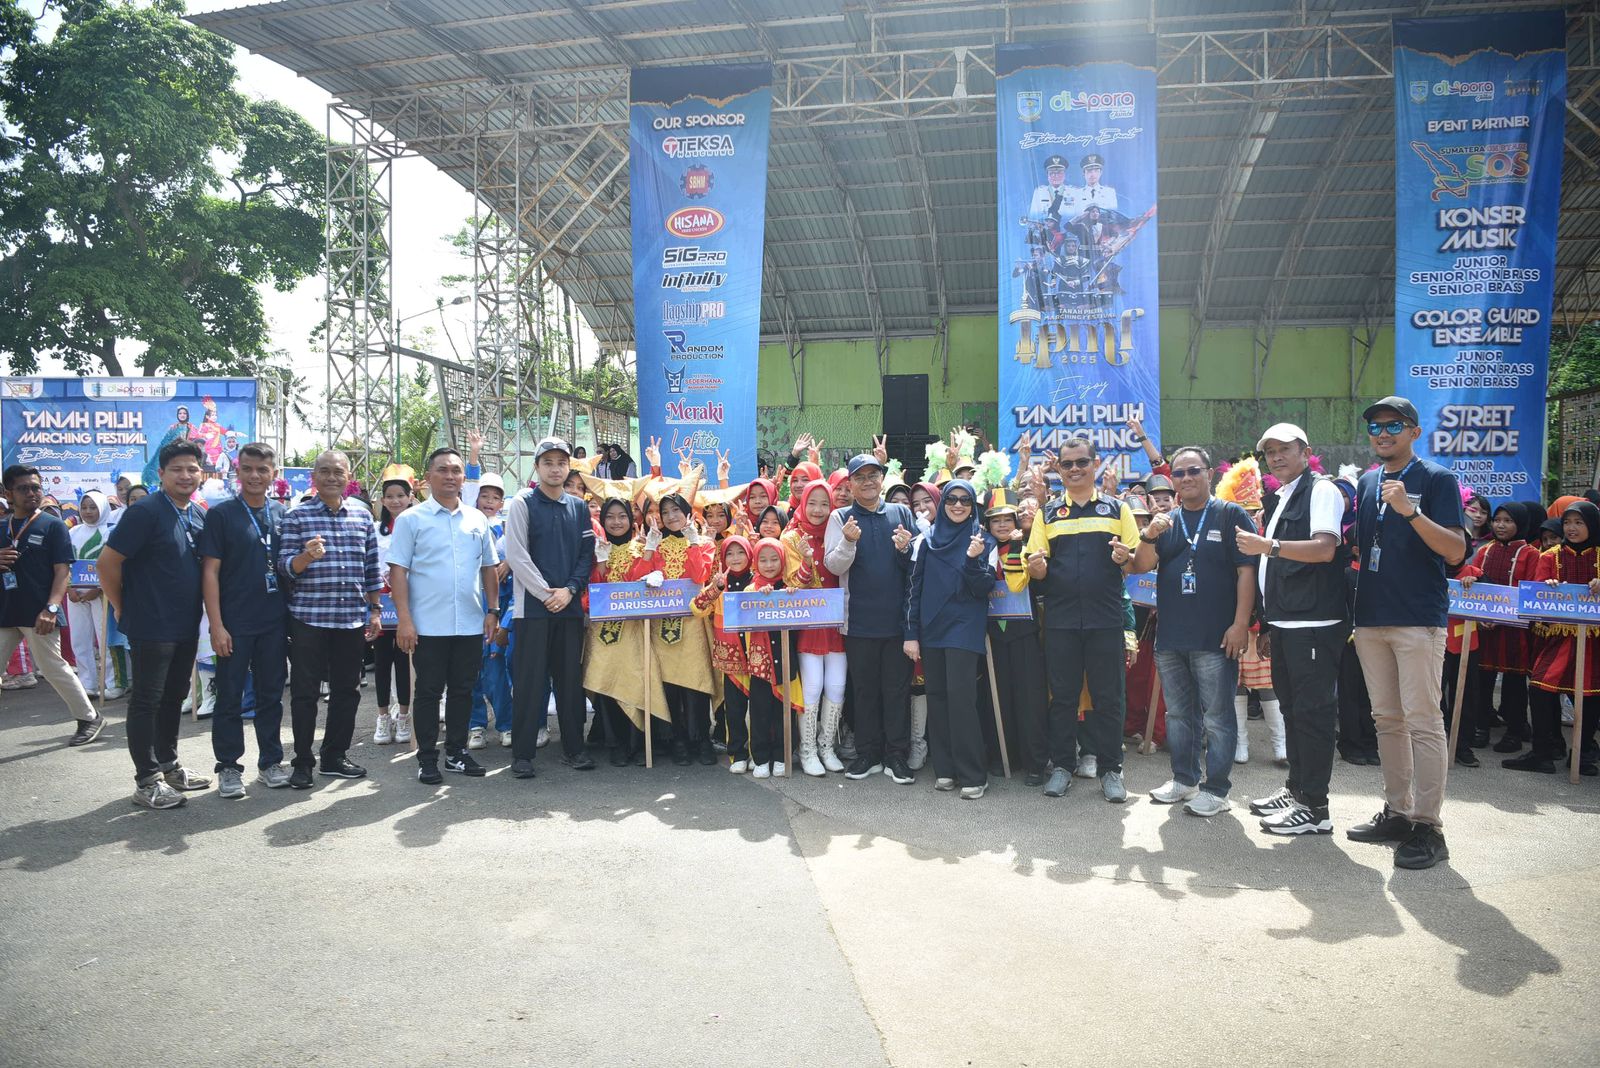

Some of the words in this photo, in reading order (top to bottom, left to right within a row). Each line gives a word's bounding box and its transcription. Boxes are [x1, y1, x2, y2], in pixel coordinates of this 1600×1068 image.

[653, 117, 682, 130] OUR
[685, 113, 745, 127] SPONSOR
[1427, 119, 1469, 133] EVENT
[1472, 115, 1530, 131] PARTNER
[677, 136, 733, 151] TEKSA
[1440, 146, 1485, 155] SUMATERA
[674, 213, 714, 230] HISANA
[1440, 206, 1526, 228] KONSER
[1440, 227, 1518, 250] MUSIK
[1454, 256, 1507, 269] JUNIOR
[1411, 271, 1465, 283] SENIOR
[1468, 269, 1500, 281] NON
[1502, 269, 1540, 281] BRASS
[1429, 284, 1484, 296] SENIOR
[1487, 282, 1524, 294] BRASS
[1413, 308, 1483, 327] COLOR
[1487, 308, 1541, 325] GUARD
[1434, 326, 1523, 345] ENSEMBLE
[671, 353, 724, 361] PRODUCTION
[1061, 355, 1097, 364] 2025
[1455, 351, 1503, 362] JUNIOR
[1411, 365, 1466, 376] SENIOR
[1469, 364, 1498, 375] NON
[1499, 364, 1533, 375] BRASS
[1429, 377, 1480, 388] SENIOR
[1482, 376, 1519, 388] BRASS
[1048, 374, 1109, 404] Enjoy
[666, 398, 724, 424] Meraki
[1013, 403, 1087, 426] TANAH
[1092, 402, 1145, 424] PILIH
[1441, 405, 1515, 428] STREET
[22, 410, 89, 428] TANAH
[95, 411, 143, 428] PILIH
[18, 432, 92, 444] MARCHING
[96, 432, 147, 444] FESTIVAL
[1433, 430, 1520, 453] PARADE
[1451, 461, 1493, 471] JUNIOR
[1463, 474, 1487, 484] NON
[1489, 472, 1527, 484] BRASS
[1476, 485, 1512, 496] BRASS
[610, 591, 641, 600] GEMA
[644, 588, 682, 598] SWARA
[1462, 591, 1511, 604] BAHANA
[1536, 591, 1573, 602] CITRA
[610, 598, 684, 611] DARUSSALAM
[740, 600, 775, 609] CITRA
[778, 598, 827, 608] BAHANA
[1458, 600, 1488, 611] KOTA
[1523, 600, 1575, 612] MAYANG
[757, 610, 811, 620] PERSADA
